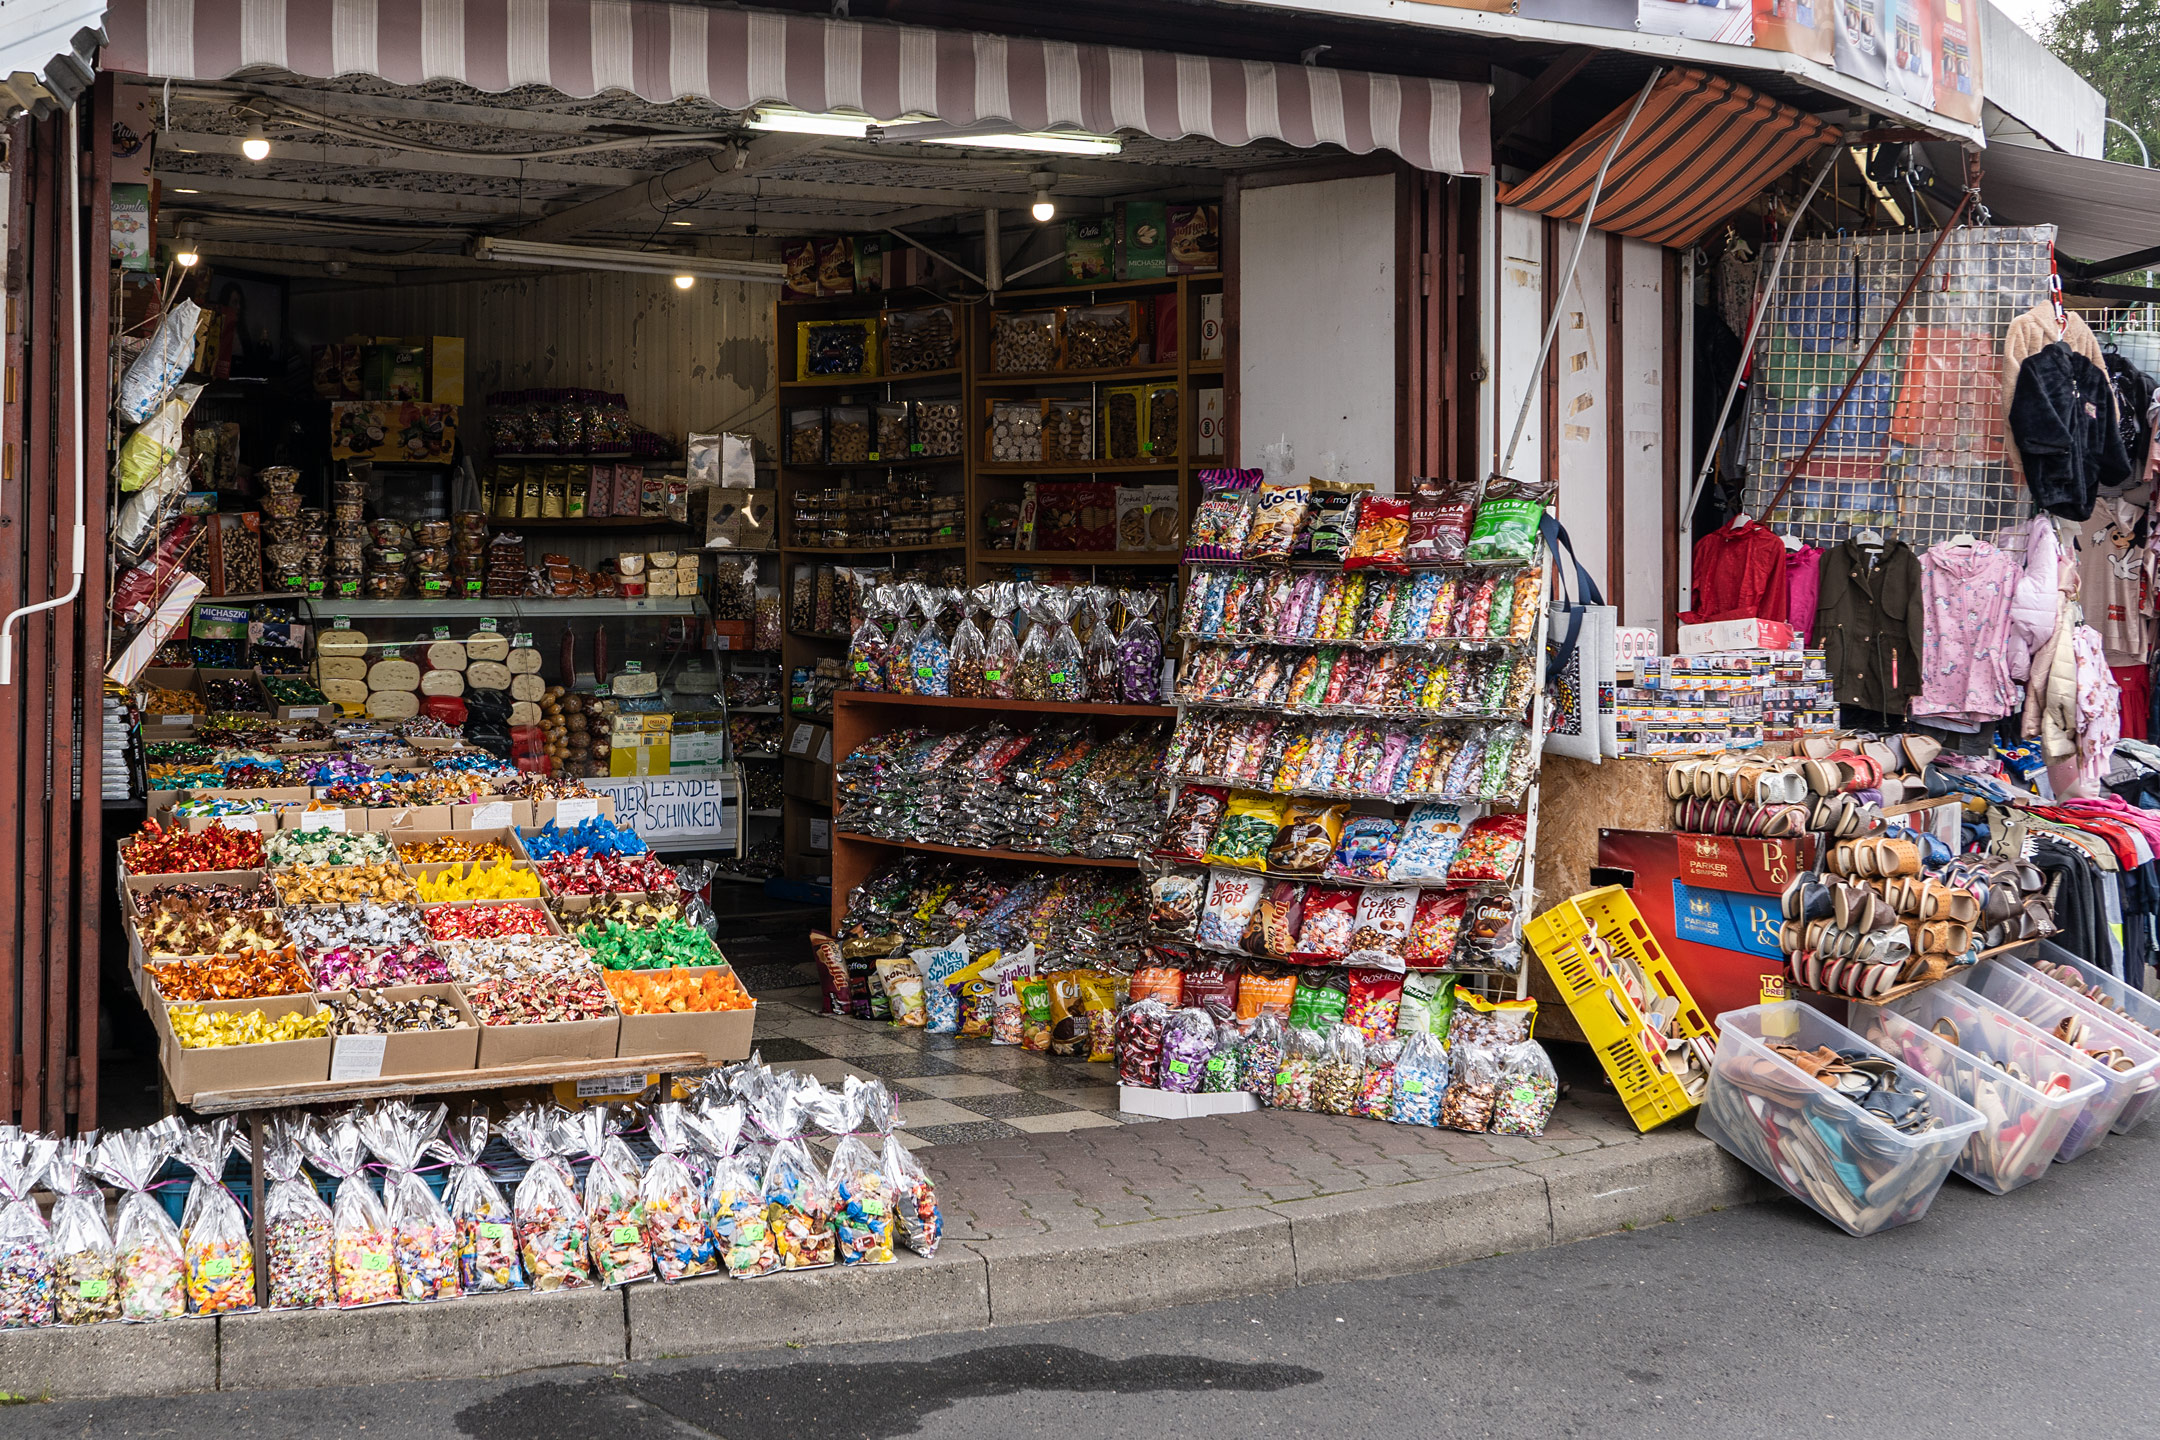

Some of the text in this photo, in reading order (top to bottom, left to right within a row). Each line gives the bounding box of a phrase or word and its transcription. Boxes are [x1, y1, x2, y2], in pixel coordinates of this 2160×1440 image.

[1128, 259, 1166, 267] MICHASZKI
[1203, 502, 1228, 510] MINI
[1371, 495, 1411, 507] ROSHEN
[200, 607, 247, 618] MICHASZKI
[650, 780, 719, 797] LENDE
[646, 801, 722, 831] SCHINKEN
[1410, 811, 1462, 824] Splash
[1690, 860, 1728, 872] PARKER
[1696, 868, 1728, 878] SIMPSON
[1213, 880, 1250, 896] Sweet
[1210, 892, 1244, 907] Drop
[1361, 896, 1411, 909] Coffee
[1366, 908, 1397, 921] Like
[1476, 905, 1514, 920] Coffex
[1272, 900, 1290, 955] Toffino
[1684, 916, 1719, 929] PARKER
[1690, 924, 1719, 935] SIMPSON
[931, 950, 963, 968] Milky
[1361, 973, 1402, 984] ROSHEN
[1762, 976, 1783, 988] TO
